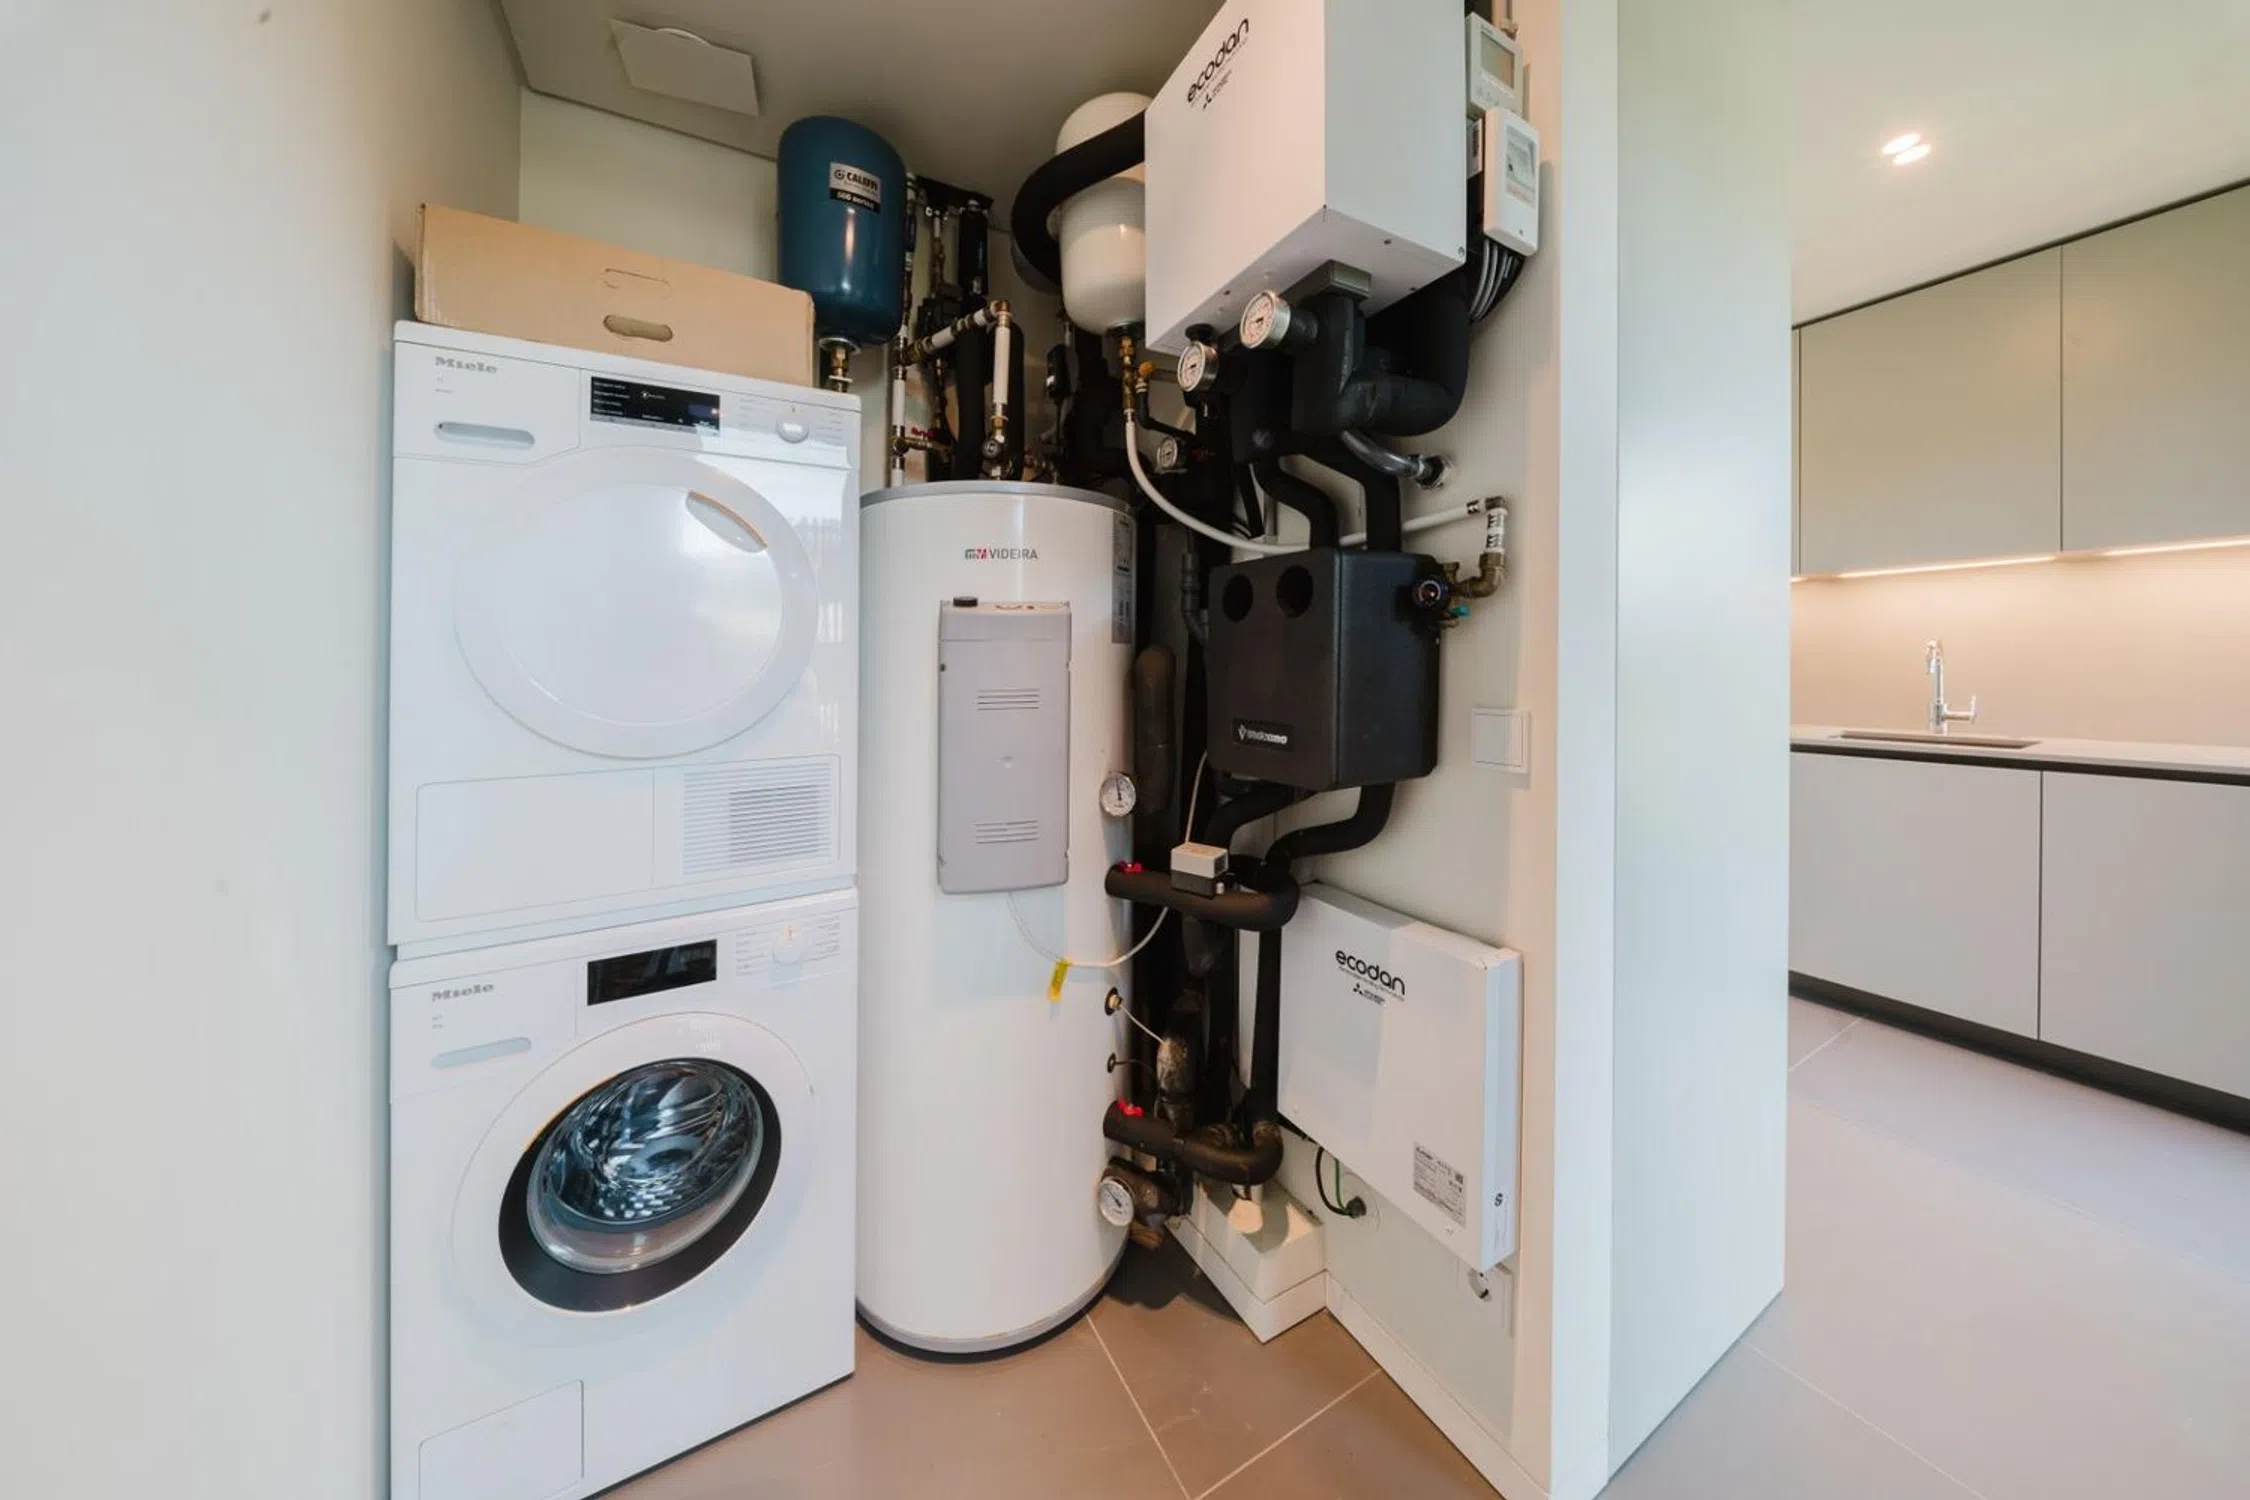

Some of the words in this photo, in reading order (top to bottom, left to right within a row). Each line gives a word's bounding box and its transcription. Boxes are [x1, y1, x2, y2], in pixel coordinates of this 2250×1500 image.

[1187, 18, 1249, 103] ecodan
[435, 356, 497, 373] Miele
[989, 548, 1038, 560] VIDEIRA
[1335, 949, 1405, 996] ecodan
[432, 984, 494, 1002] Miele
